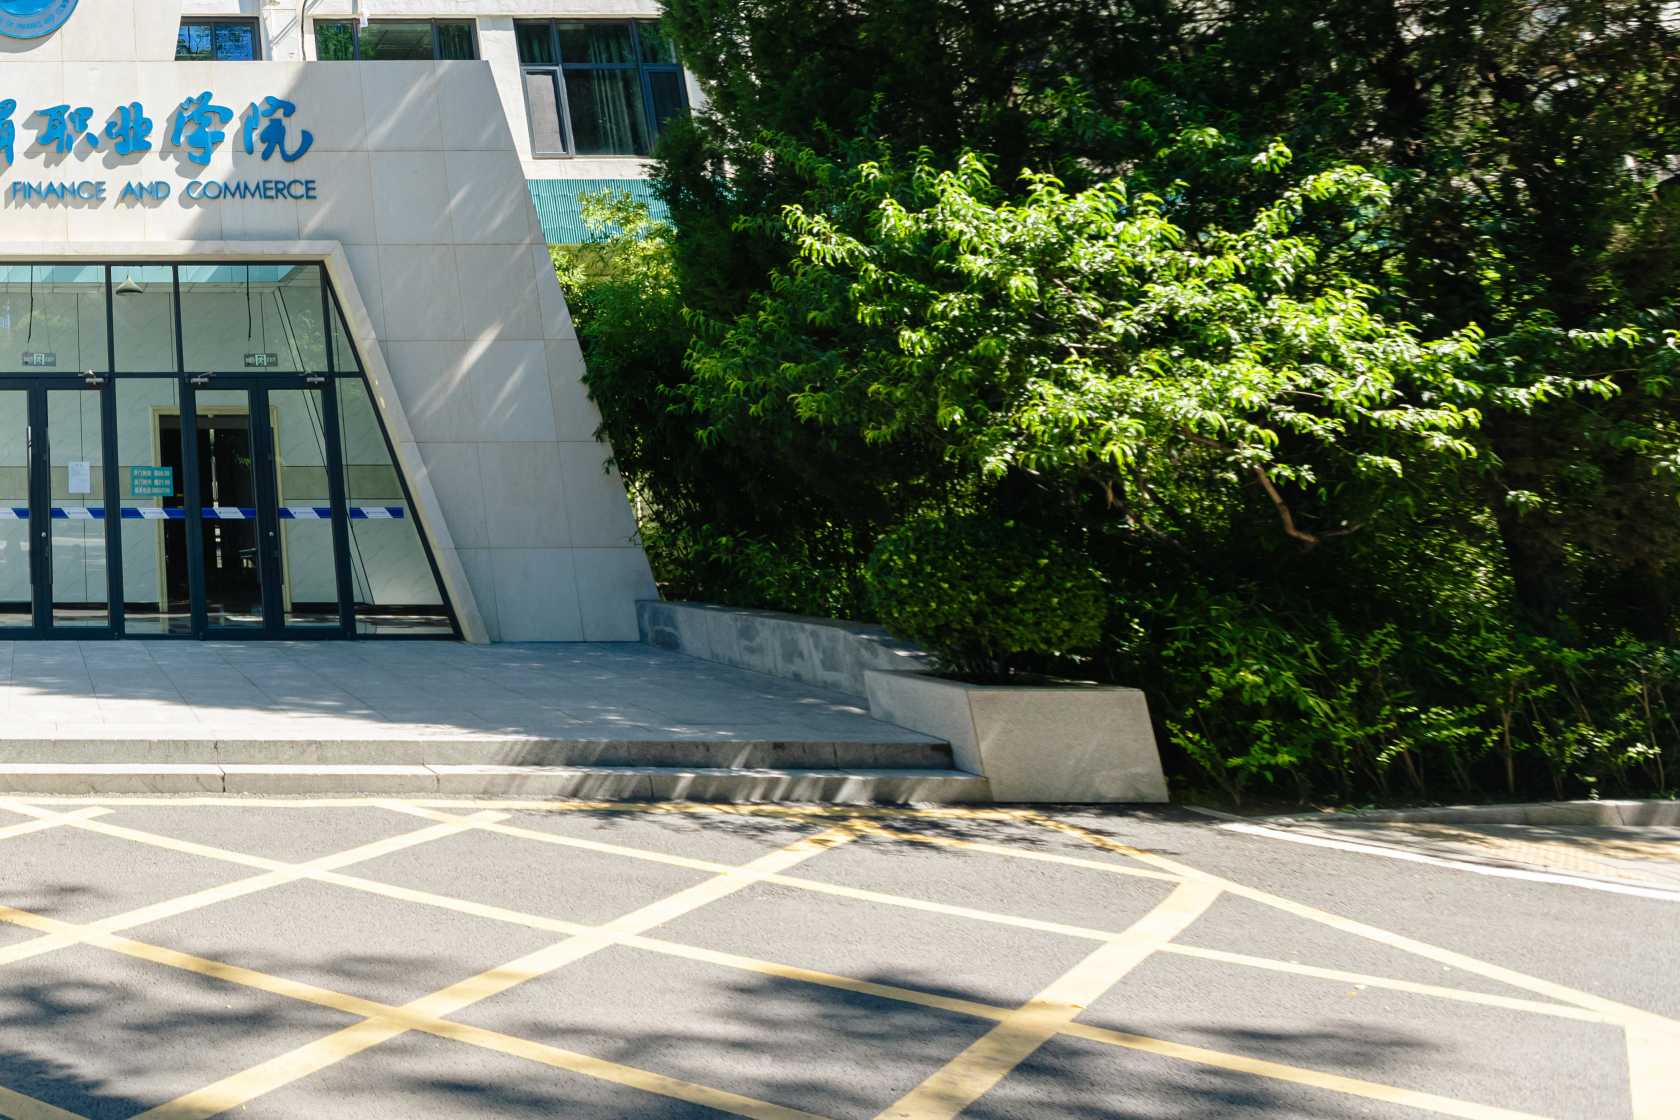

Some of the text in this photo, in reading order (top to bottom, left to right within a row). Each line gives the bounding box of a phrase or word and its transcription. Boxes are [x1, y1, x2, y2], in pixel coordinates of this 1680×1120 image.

[12, 180, 106, 200] FINANCE
[122, 180, 171, 200] AND
[186, 179, 317, 200] COMMERCE
